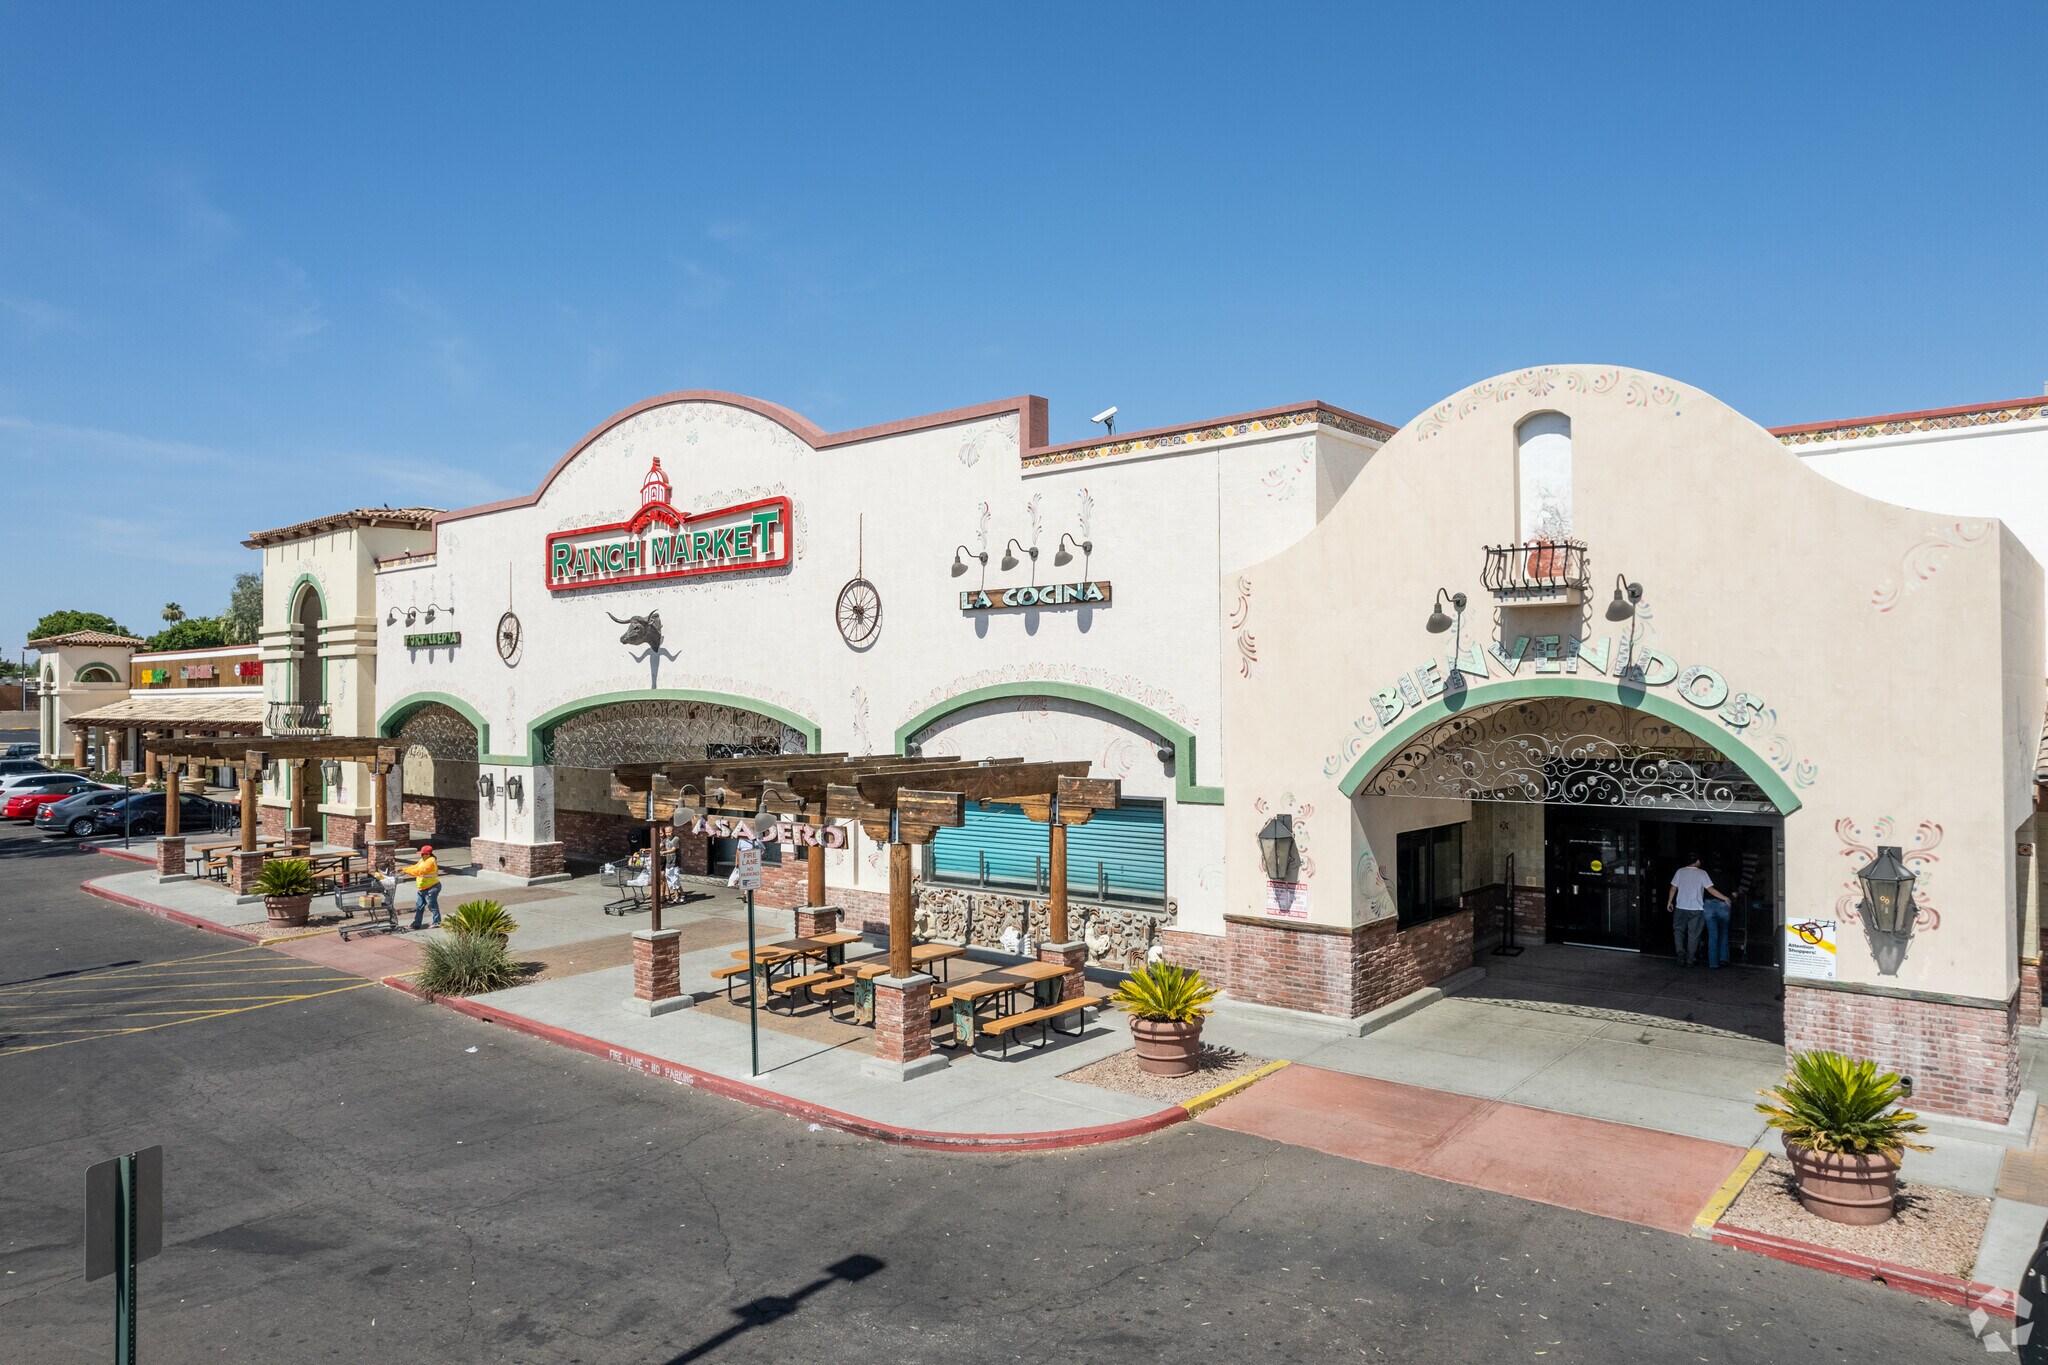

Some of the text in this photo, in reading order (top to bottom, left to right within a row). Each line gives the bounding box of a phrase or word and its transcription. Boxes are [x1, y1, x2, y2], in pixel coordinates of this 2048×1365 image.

[552, 510, 778, 579] RANCH MARKET
[961, 582, 1104, 609] LA COCINA
[1369, 634, 1765, 728] BIENVENIDOS
[692, 818, 844, 848] ASADERO
[609, 1049, 623, 1062] FIRE
[625, 1055, 643, 1069] LANE
[651, 1063, 661, 1074] NO
[665, 1067, 694, 1084] PARKING
